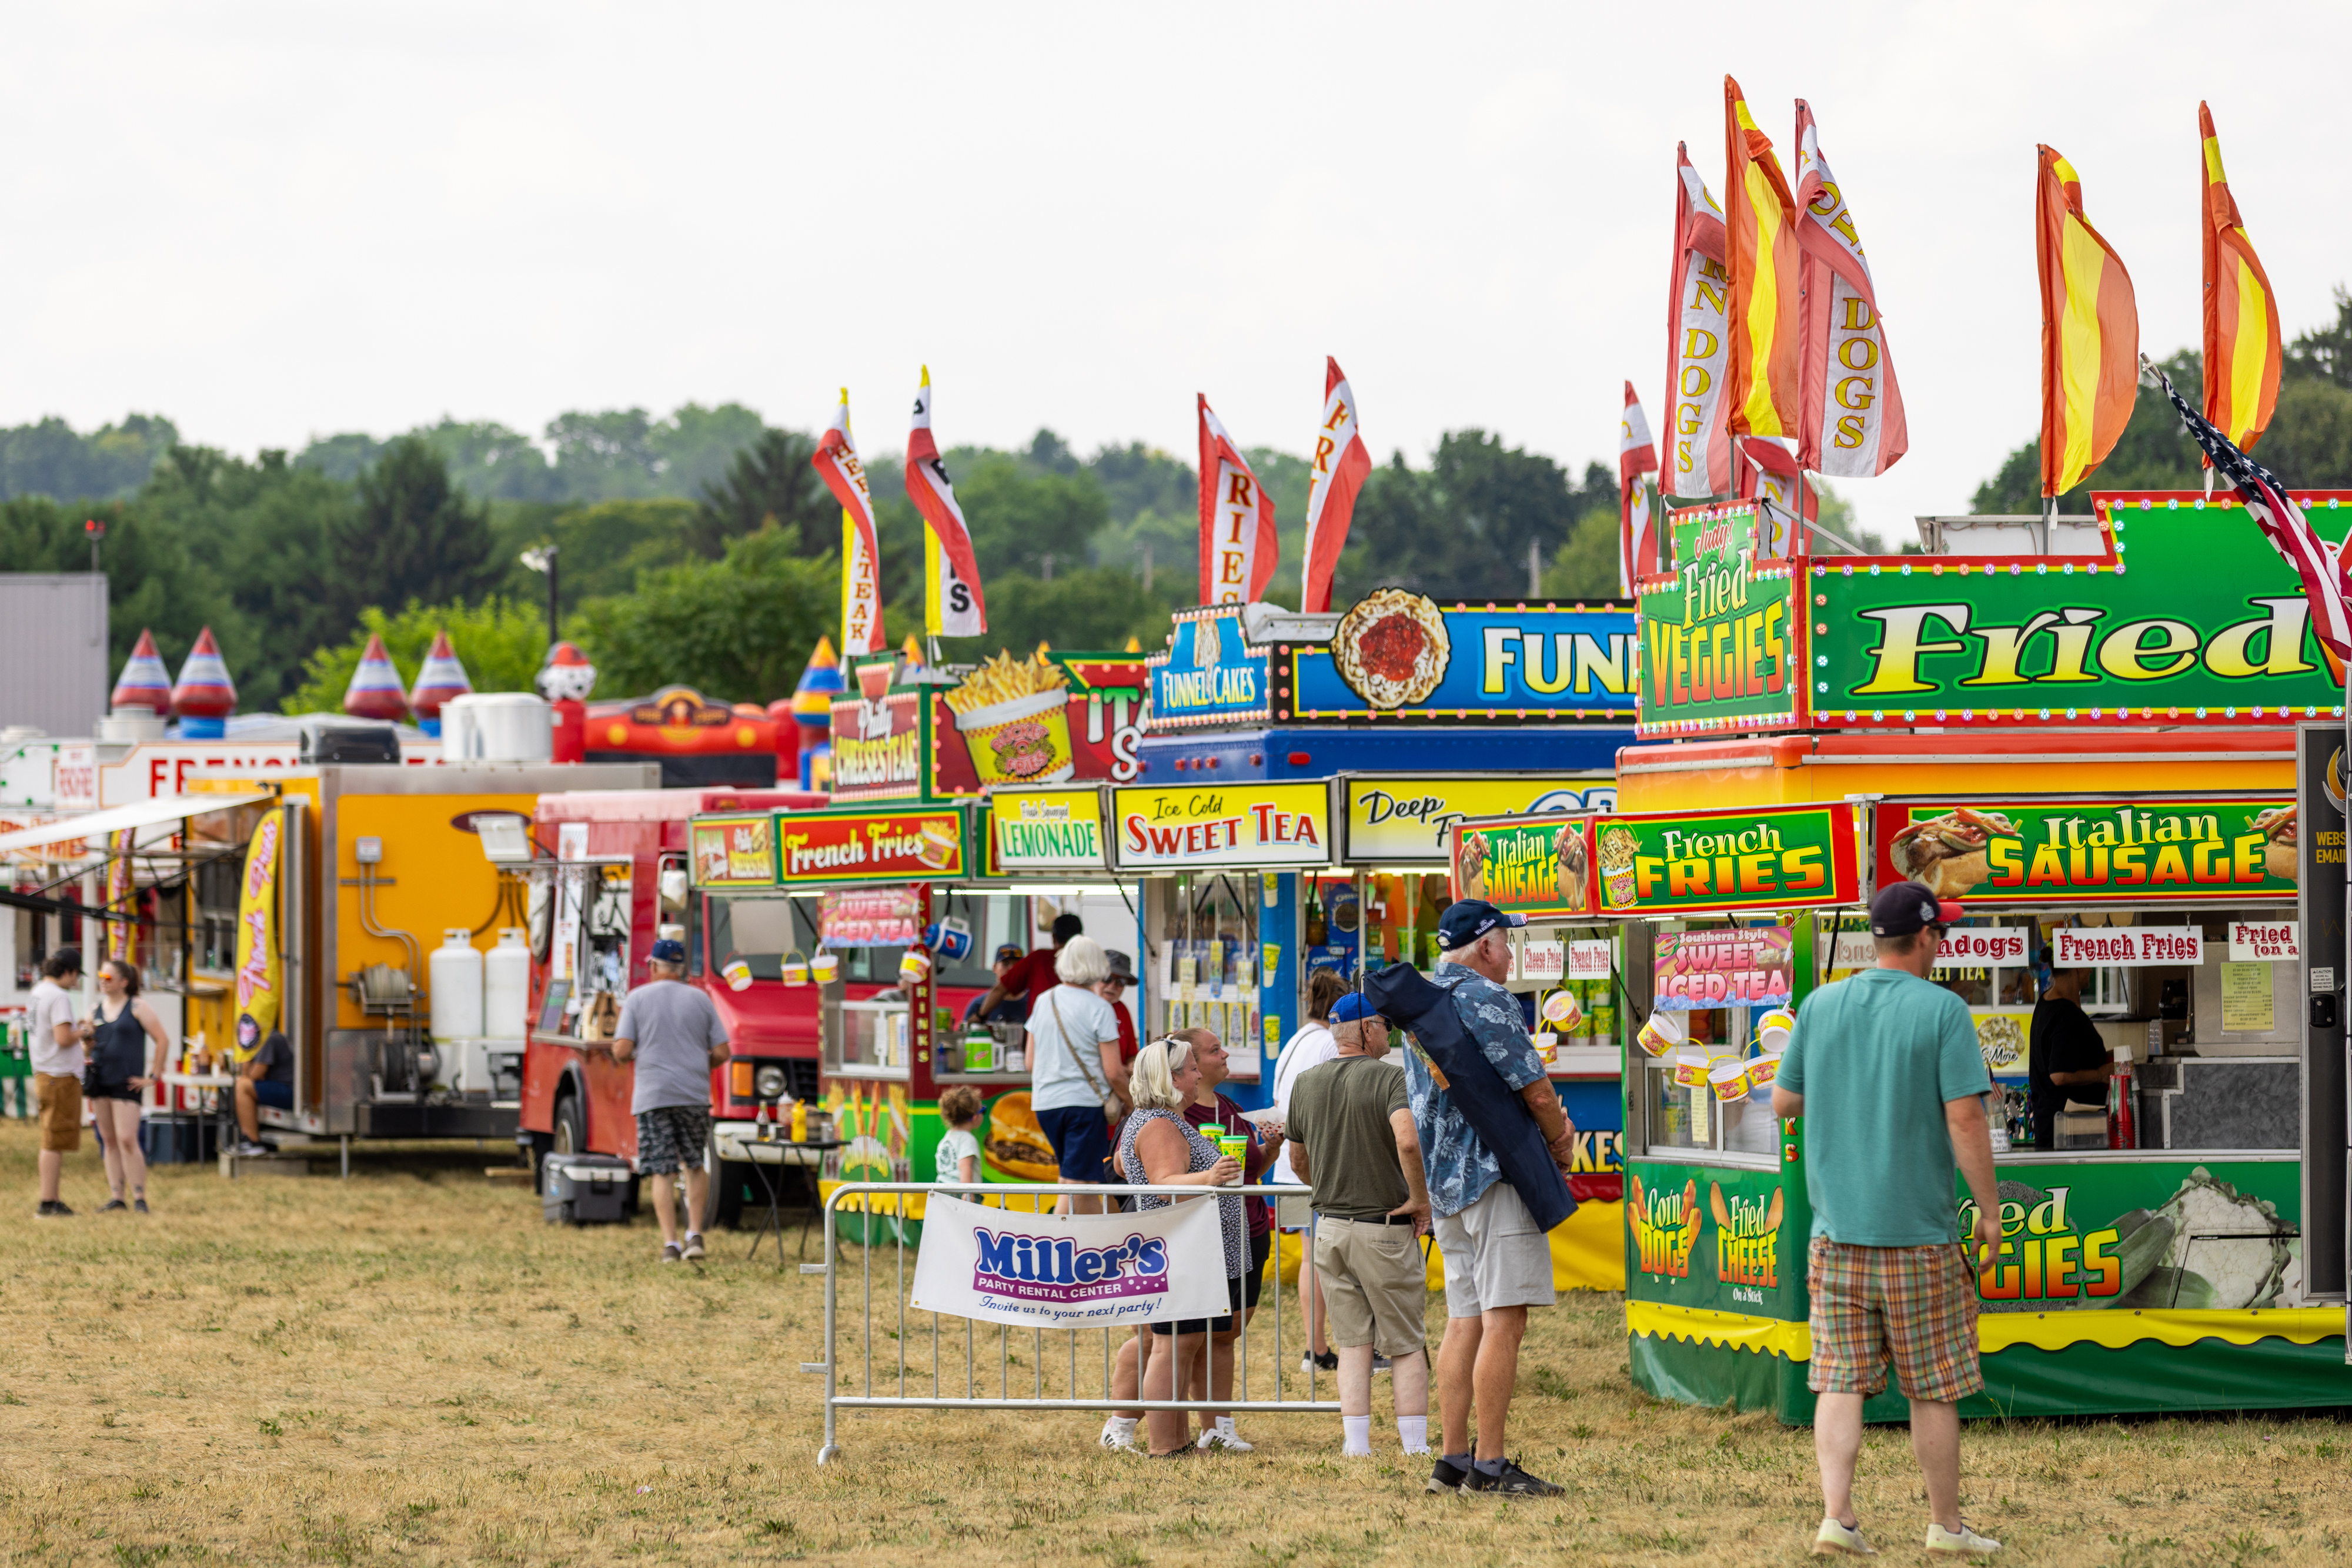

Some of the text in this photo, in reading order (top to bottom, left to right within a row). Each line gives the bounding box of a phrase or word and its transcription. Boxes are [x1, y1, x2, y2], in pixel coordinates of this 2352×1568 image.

[1834, 297, 1879, 449] DOGS
[1678, 329, 1718, 473] DOGS
[1695, 517, 1734, 562] Judy's
[1683, 548, 1748, 630] Fried
[1483, 627, 1636, 694] FUN
[1649, 600, 1784, 708] VEGGIES
[1850, 597, 2318, 695] Fried
[1162, 667, 1255, 709] FUNNEL CAKES
[858, 697, 894, 744] Philly
[990, 722, 1050, 753] BUCKET
[1005, 748, 1048, 775] FRIES
[1153, 795, 1222, 821] Ice Cold
[1359, 790, 1444, 824] Deep
[786, 821, 925, 874] French Fries
[1001, 821, 1098, 857] LEMONADE
[1126, 803, 1319, 858] SWEET TEA
[1496, 827, 1546, 870] Italian
[1662, 823, 1785, 863] French
[2041, 805, 2220, 851] Italian
[1483, 852, 1559, 905] SAUSAGE
[1633, 844, 1825, 898] FRIES
[1987, 830, 2269, 889] SAUSAGE
[1609, 877, 1635, 892] BUCKET
[1615, 890, 1633, 904] FRIES
[825, 918, 914, 942] ICED TEA
[838, 900, 901, 921] SWEET
[1679, 929, 1769, 944] Southern Style
[1936, 935, 2023, 960] ndogs
[2060, 933, 2198, 961] French Fries
[2235, 925, 2293, 944] Fried
[2254, 944, 2298, 958] (on a
[1524, 947, 1546, 973] Cheese
[1546, 948, 1562, 972] Fries
[1571, 946, 1609, 972] French Fries
[1675, 941, 1765, 973] SWEET
[1659, 969, 1788, 1002] ICED TEA
[1647, 1188, 1681, 1231] Corn
[1729, 1194, 1765, 1241] Fried
[976, 1228, 1165, 1285] Miller's
[1640, 1220, 1689, 1279] DOGS
[1718, 1224, 1778, 1289] CHEESE
[1978, 1226, 2122, 1300] GIES
[978, 1278, 1122, 1299] PARTY RENTAL CENTER
[980, 1295, 1162, 1322] Invite us to your next party!
[1733, 1288, 1743, 1301] On
[1748, 1288, 1763, 1305] Stick
